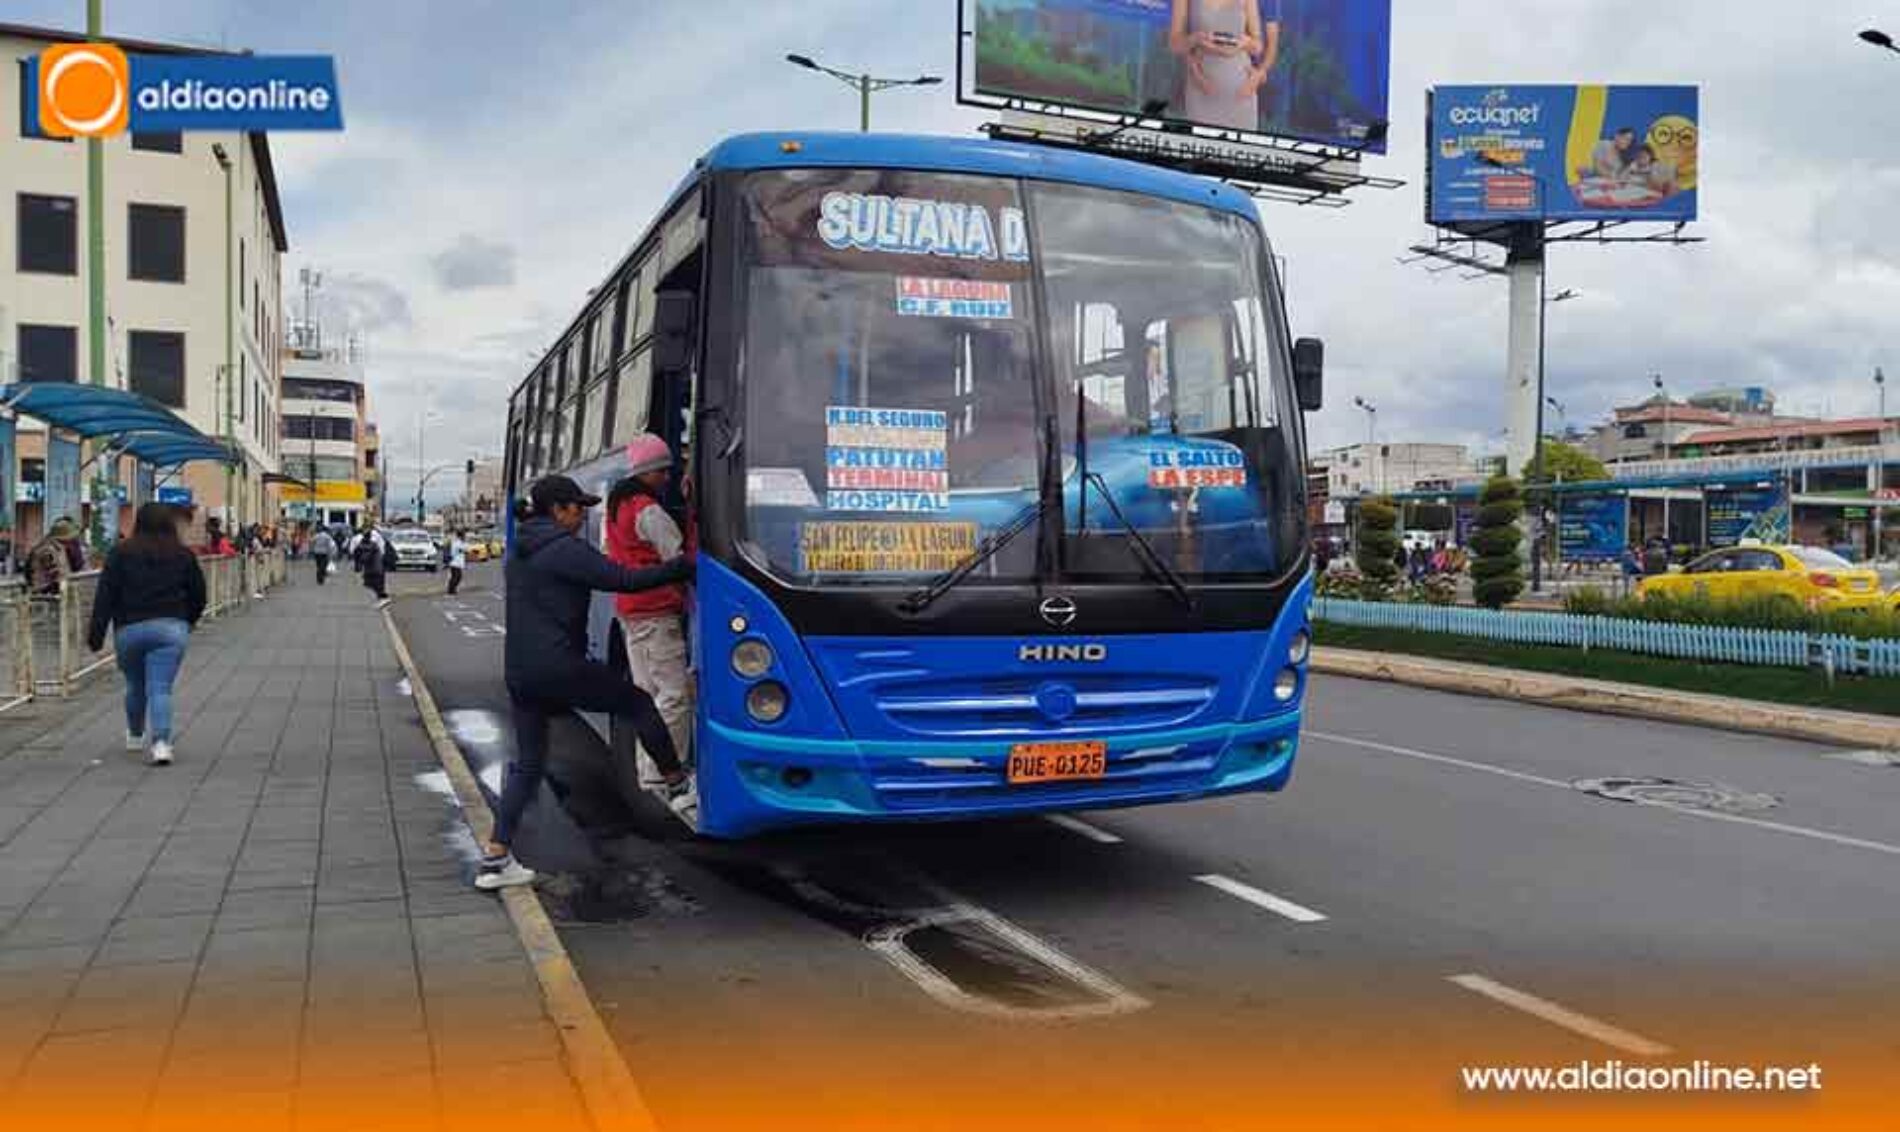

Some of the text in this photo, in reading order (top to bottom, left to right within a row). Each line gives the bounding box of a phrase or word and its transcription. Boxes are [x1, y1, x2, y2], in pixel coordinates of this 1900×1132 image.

[818, 192, 998, 260] SULTANA
[878, 411, 946, 428] SEGURO
[1149, 450, 1243, 467] EL SALTO
[828, 468, 946, 490] TERMINAL
[1149, 469, 1180, 488] LA
[827, 491, 949, 510] HOSPITAL
[1018, 643, 1108, 661] HINO
[1012, 754, 1102, 777] PUE-0125
